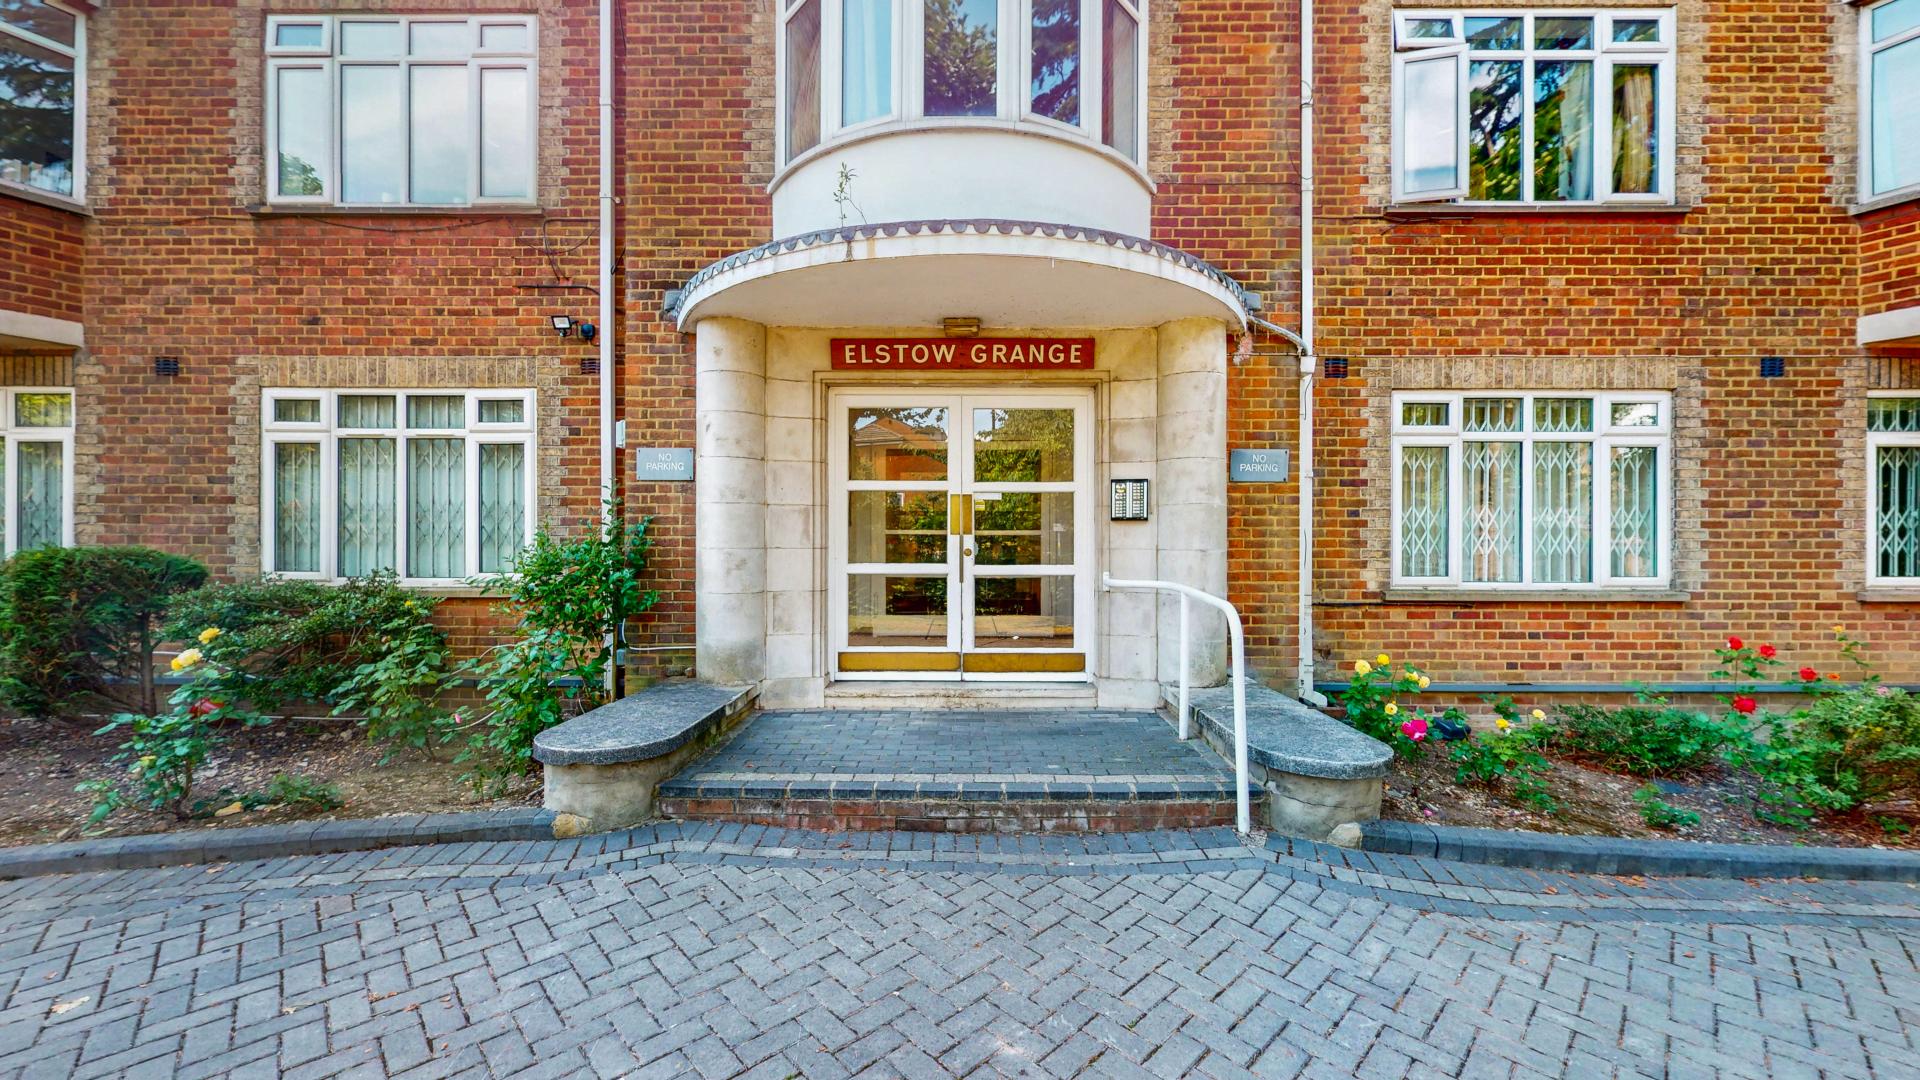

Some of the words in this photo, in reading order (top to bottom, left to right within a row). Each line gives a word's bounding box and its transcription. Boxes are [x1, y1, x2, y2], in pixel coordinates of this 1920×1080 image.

[844, 344, 956, 364] ELSTOW
[970, 344, 1082, 364] GRANGE
[658, 453, 672, 461] NO
[1252, 454, 1267, 463] NO
[646, 462, 685, 471] PARKING
[1239, 463, 1280, 472] PARKING
